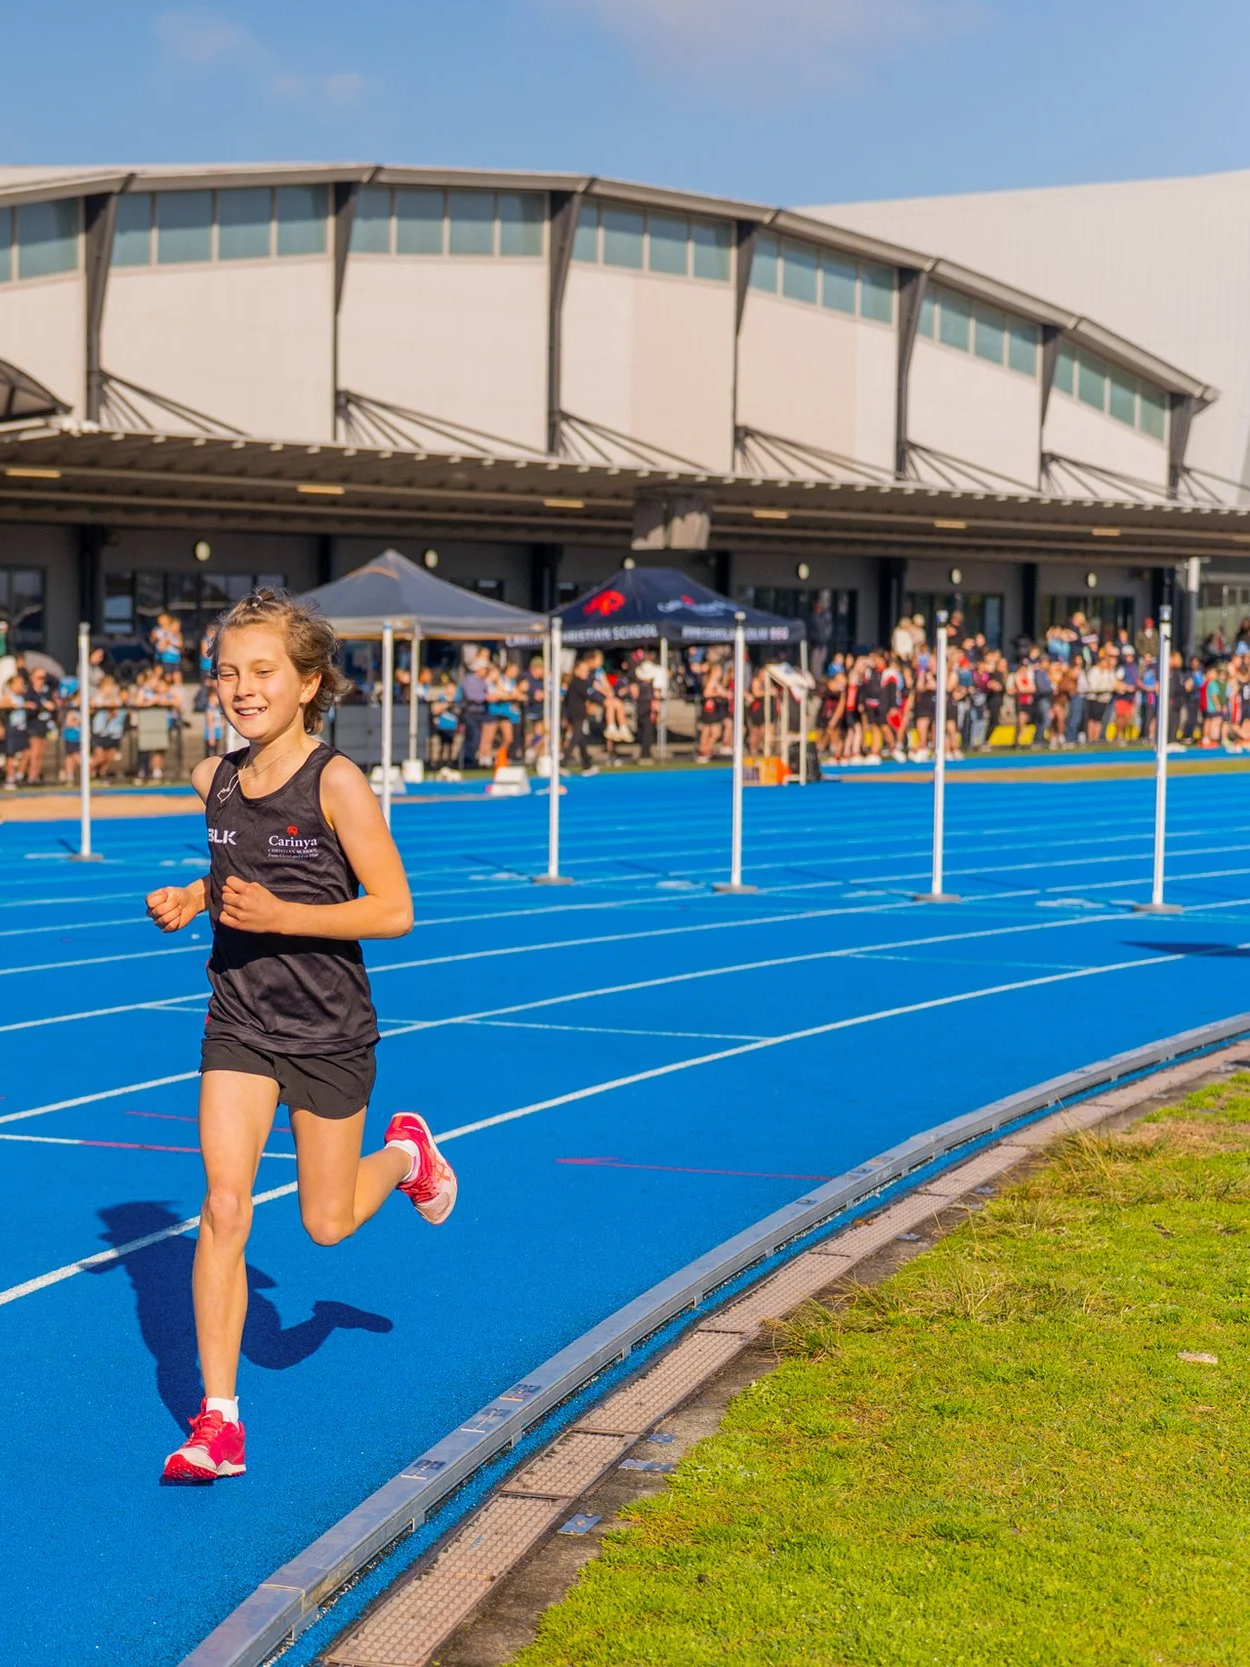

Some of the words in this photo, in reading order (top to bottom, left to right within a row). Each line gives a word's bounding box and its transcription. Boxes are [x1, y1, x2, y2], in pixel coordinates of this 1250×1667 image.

[612, 624, 659, 641] SCHOOL
[208, 828, 237, 845] BLK
[268, 835, 318, 850] Carinya
